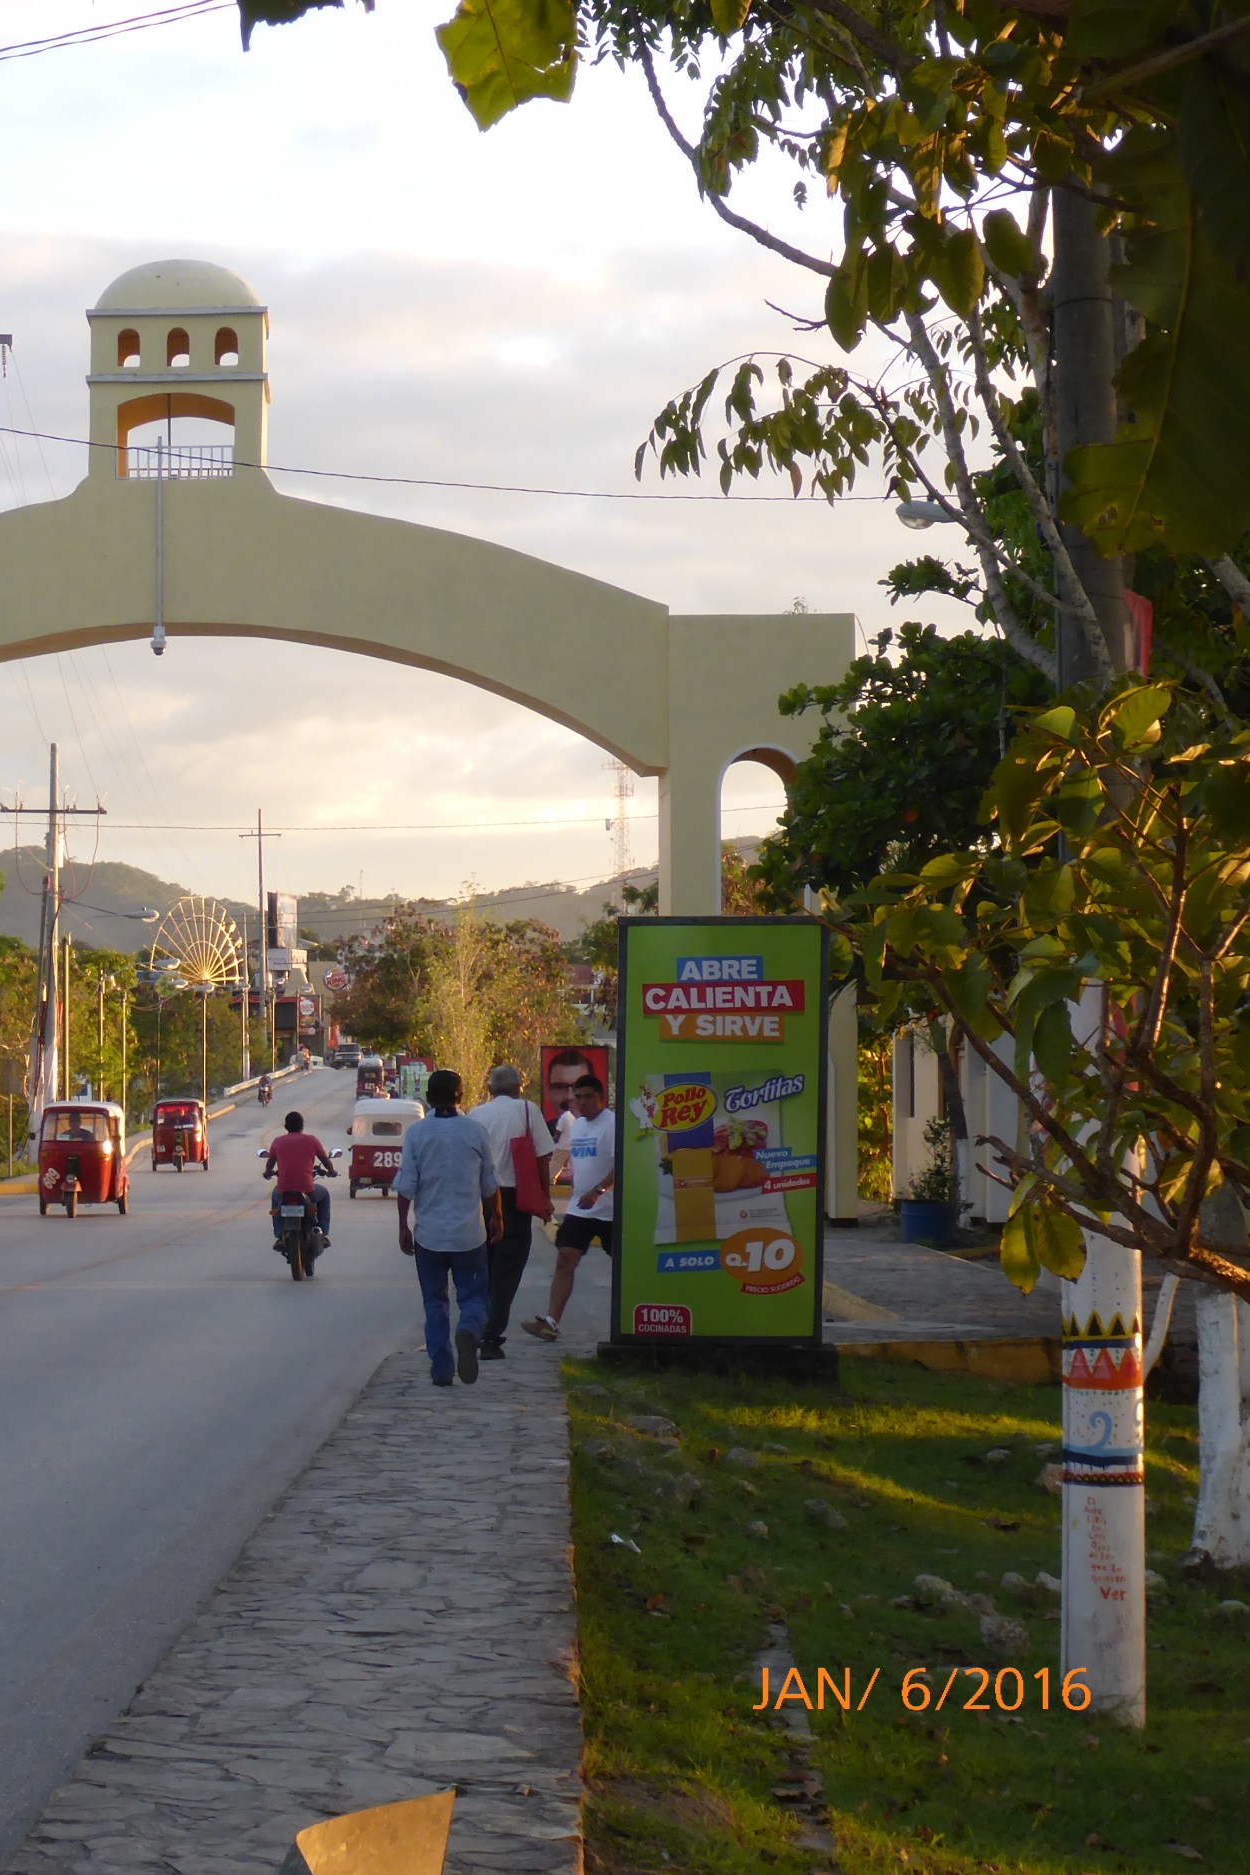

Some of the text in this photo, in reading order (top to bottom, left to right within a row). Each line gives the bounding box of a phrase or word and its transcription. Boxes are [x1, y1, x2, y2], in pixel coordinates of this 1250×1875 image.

[680, 959, 759, 981] ABRE
[645, 985, 793, 1010] CALIENTA
[665, 1014, 780, 1037] Y SIRVE
[662, 1086, 707, 1108] Pollo
[724, 1074, 805, 1113] Tortitas
[659, 1099, 709, 1128] Rey
[373, 1151, 402, 1168] 289
[756, 1151, 788, 1160] Nuevo
[766, 1158, 811, 1171] Empaque
[763, 1178, 810, 1190] 4 unidades
[665, 1258, 675, 1268] A
[679, 1256, 715, 1268] SOLO
[744, 1284, 769, 1294] PRECIO
[641, 1308, 684, 1323] 100%
[638, 1323, 687, 1334] COCINADAS
[1100, 1586, 1127, 1601] Ver
